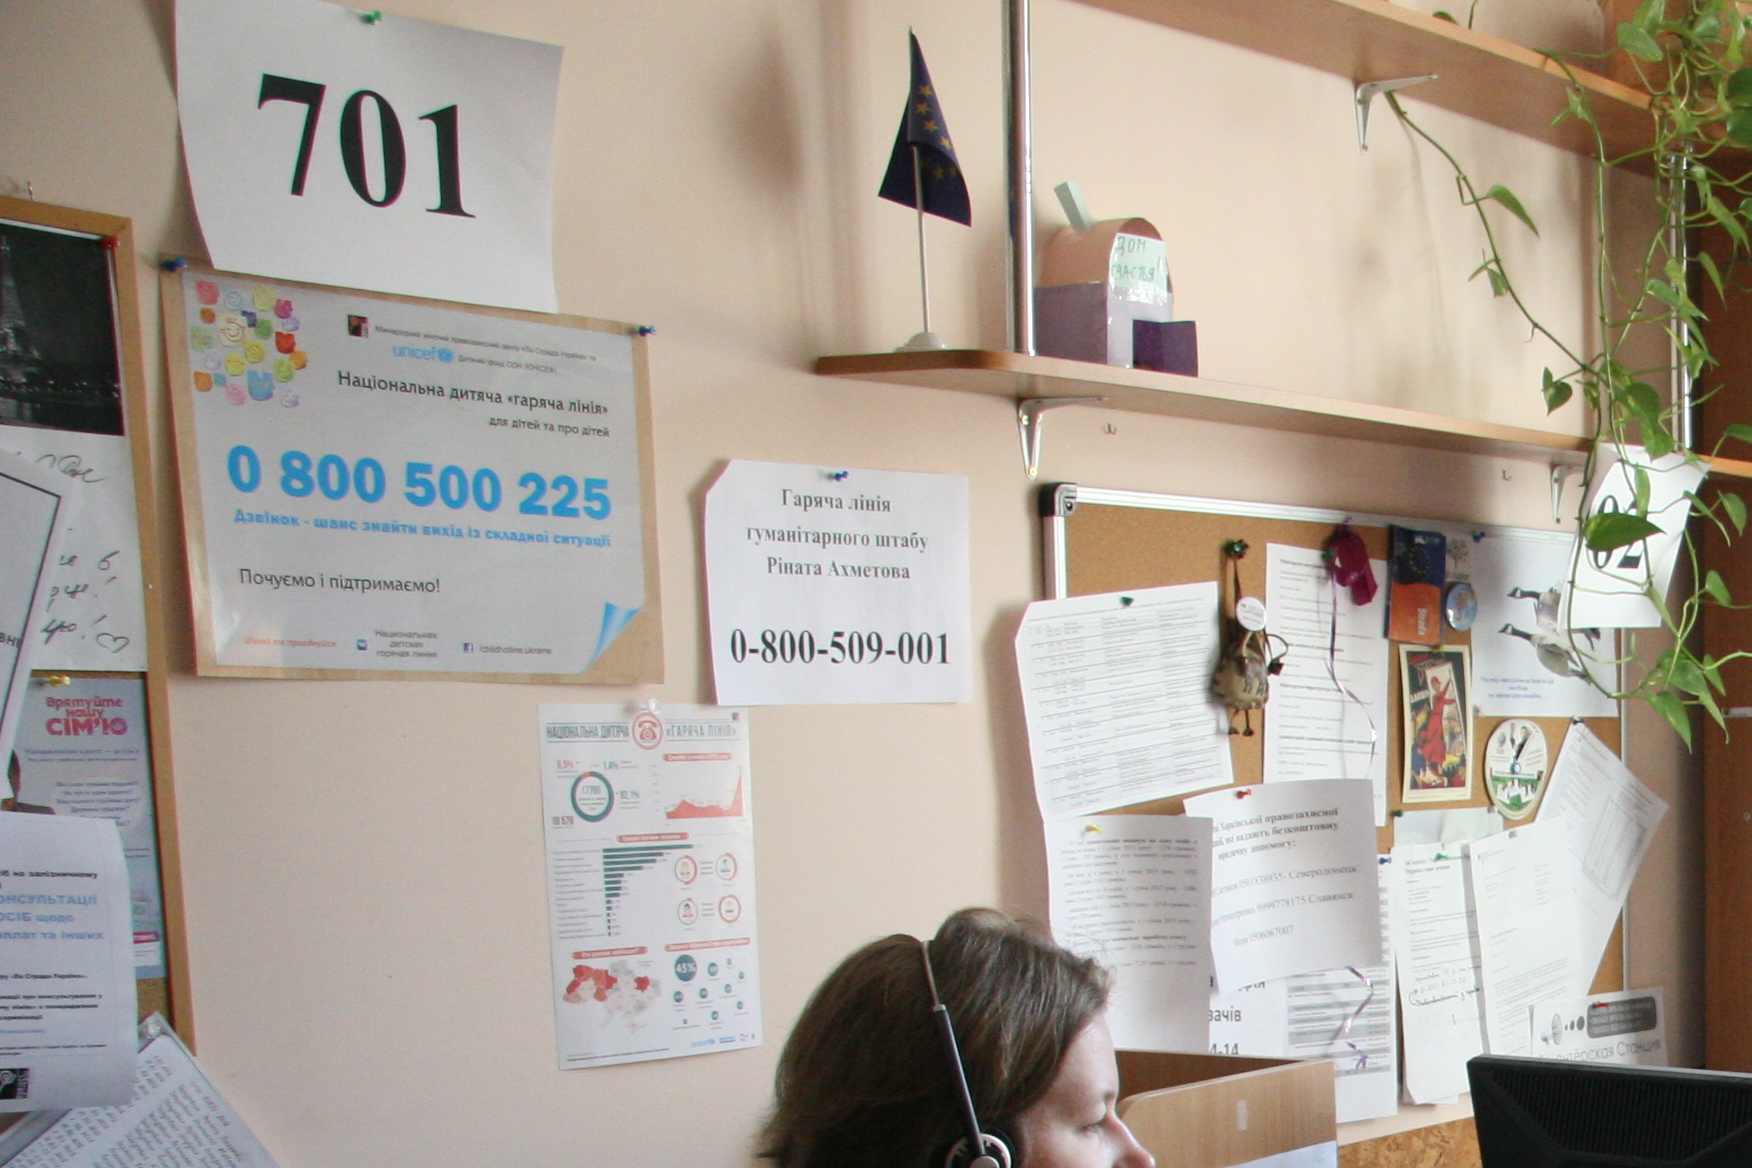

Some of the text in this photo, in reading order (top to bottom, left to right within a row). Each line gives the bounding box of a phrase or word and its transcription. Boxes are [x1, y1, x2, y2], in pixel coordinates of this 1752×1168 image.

[257, 73, 476, 219] 701
[393, 345, 437, 361] unicef
[338, 371, 608, 415] Національна дитяча «гаряча лінія»
[489, 417, 610, 438] для дітей та про дітей
[227, 444, 612, 520] 0 800 500 225
[781, 489, 891, 512] Гаряча лінія
[234, 509, 300, 527] Дзвінок
[313, 517, 358, 531] шанс
[362, 519, 417, 535] знайти
[423, 523, 464, 539] вихід
[469, 525, 480, 539] із
[486, 529, 549, 543] складної
[553, 533, 611, 548] ситуації
[747, 526, 929, 553] гуманітарного штабу
[767, 557, 910, 579] Ріната Ахметова
[240, 568, 441, 594] Почуємо і підтримаємо!
[731, 628, 951, 665] 0-800-509-001
[46, 696, 123, 710] Врятуйте
[66, 709, 104, 718] нашу
[46, 717, 128, 736] СІМ'Ю
[546, 724, 629, 739] НАЦІОНАЛЬНА ДИТЯЧА
[36, 915, 74, 923] щодо
[62, 930, 103, 940] інших
